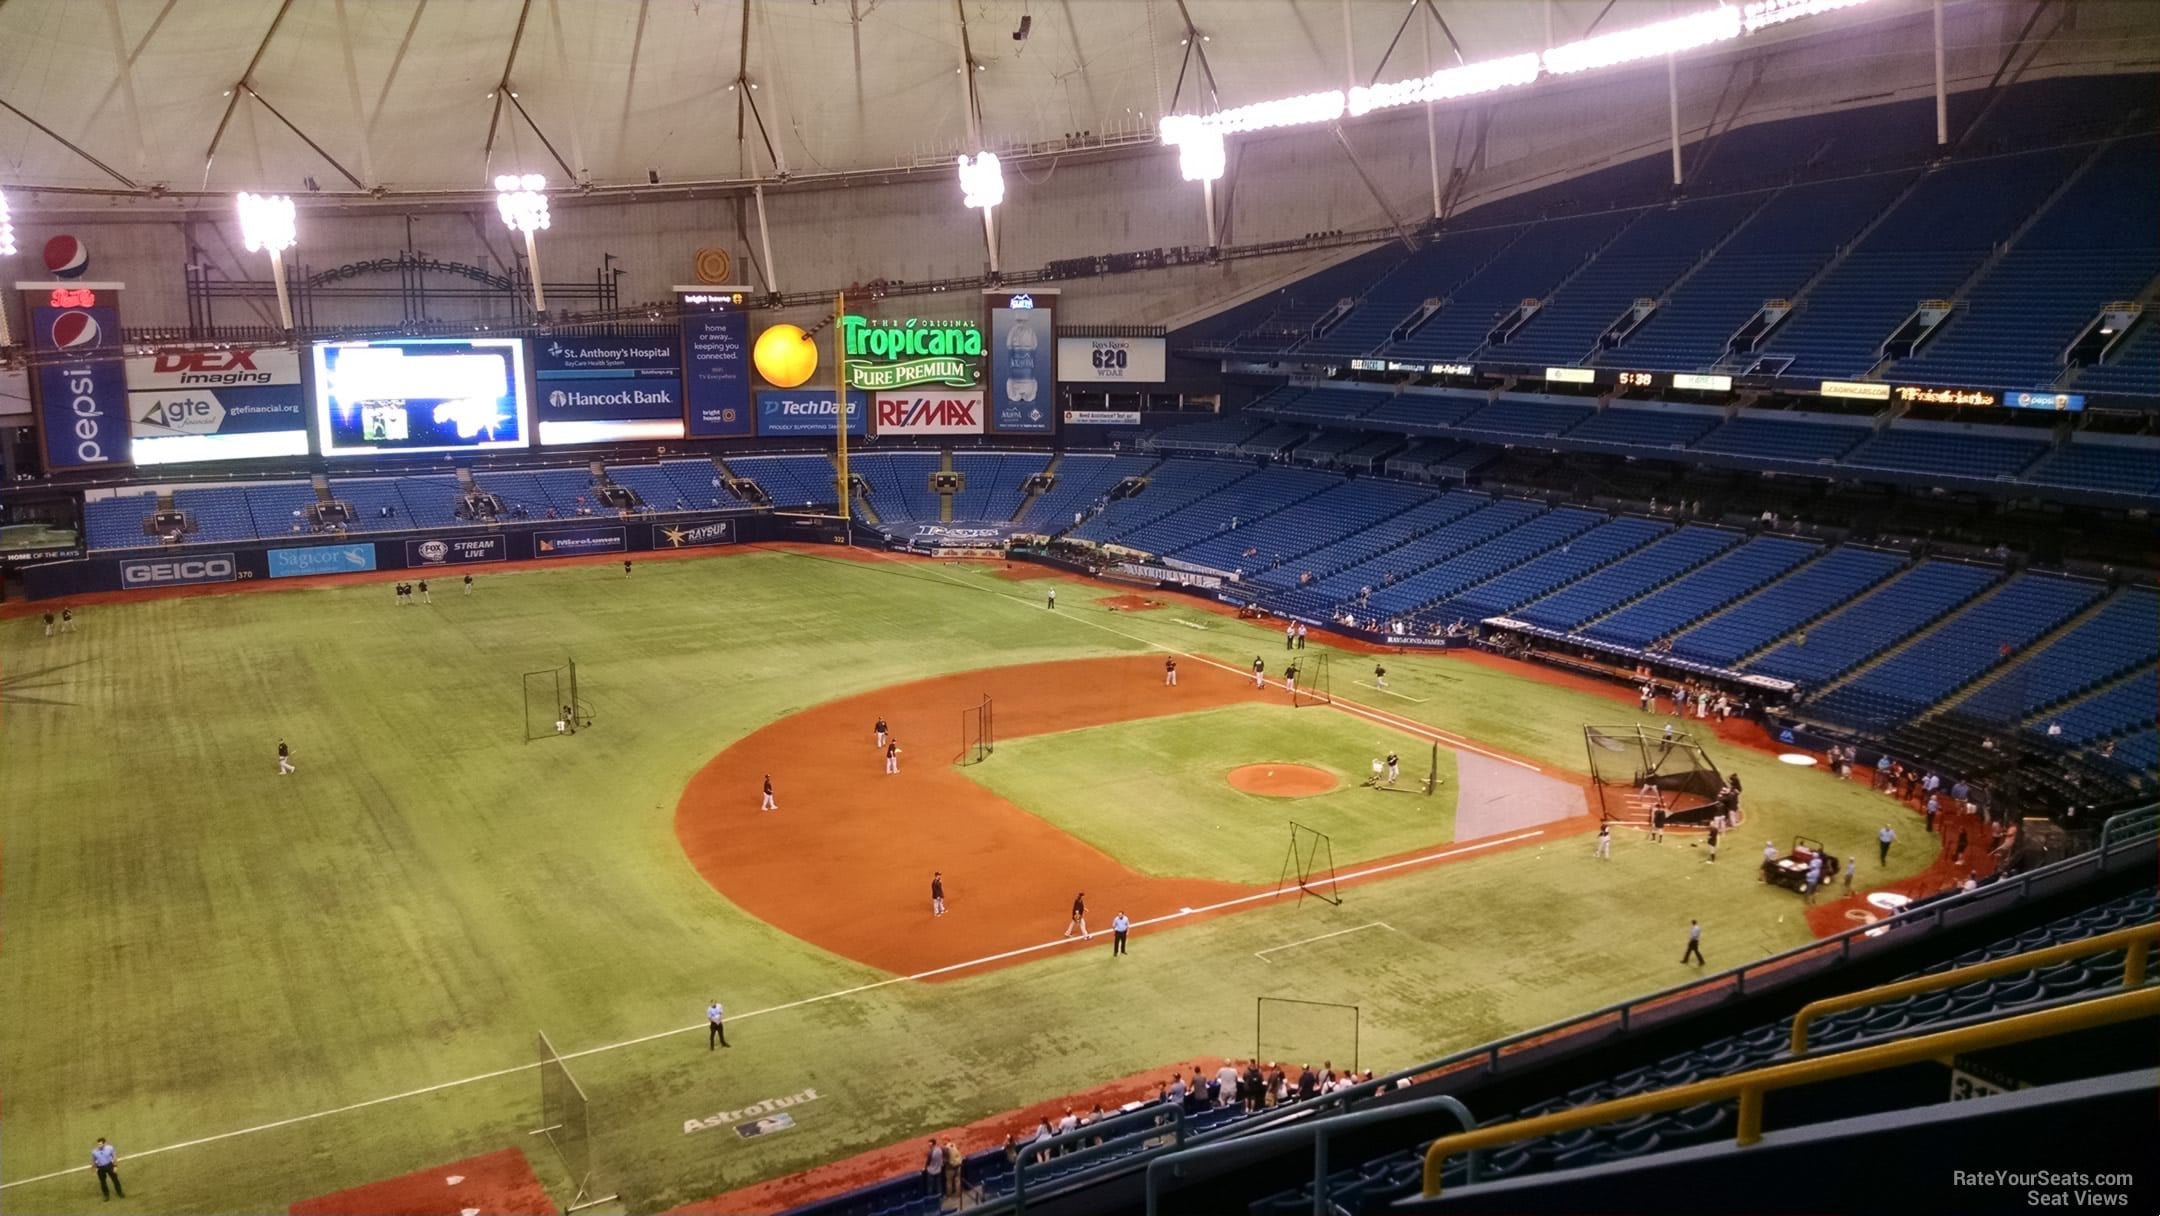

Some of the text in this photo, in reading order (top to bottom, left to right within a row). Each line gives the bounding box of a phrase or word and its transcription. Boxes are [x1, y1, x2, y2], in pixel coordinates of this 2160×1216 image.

[922, 319, 976, 327] ORIGINAL
[836, 316, 983, 360] Tropicana
[564, 346, 670, 360] St. Anthony's Hospital
[694, 342, 739, 351] keeping you
[153, 347, 257, 373] DEX
[1092, 350, 1127, 368] 620
[180, 371, 272, 385] imaging
[854, 362, 965, 386] PURE PREMIUM
[1619, 372, 1652, 386] 5:38
[568, 389, 671, 406] Hancock Bank
[168, 398, 210, 422] gte
[230, 403, 300, 416] gtefinancial.org
[782, 400, 857, 415] Tech Daa
[879, 398, 977, 428] RE/MAX
[64, 369, 109, 462] pepsi
[424, 544, 442, 552] FOX
[453, 540, 495, 551] STREAM
[556, 536, 621, 547] MicroLumen
[44, 552, 58, 560] THE
[279, 550, 340, 569] Sagicor
[464, 549, 485, 558] LIVE
[125, 559, 232, 583] GEICO
[238, 570, 253, 579] 370
[683, 1087, 823, 1135] AstroTurf
